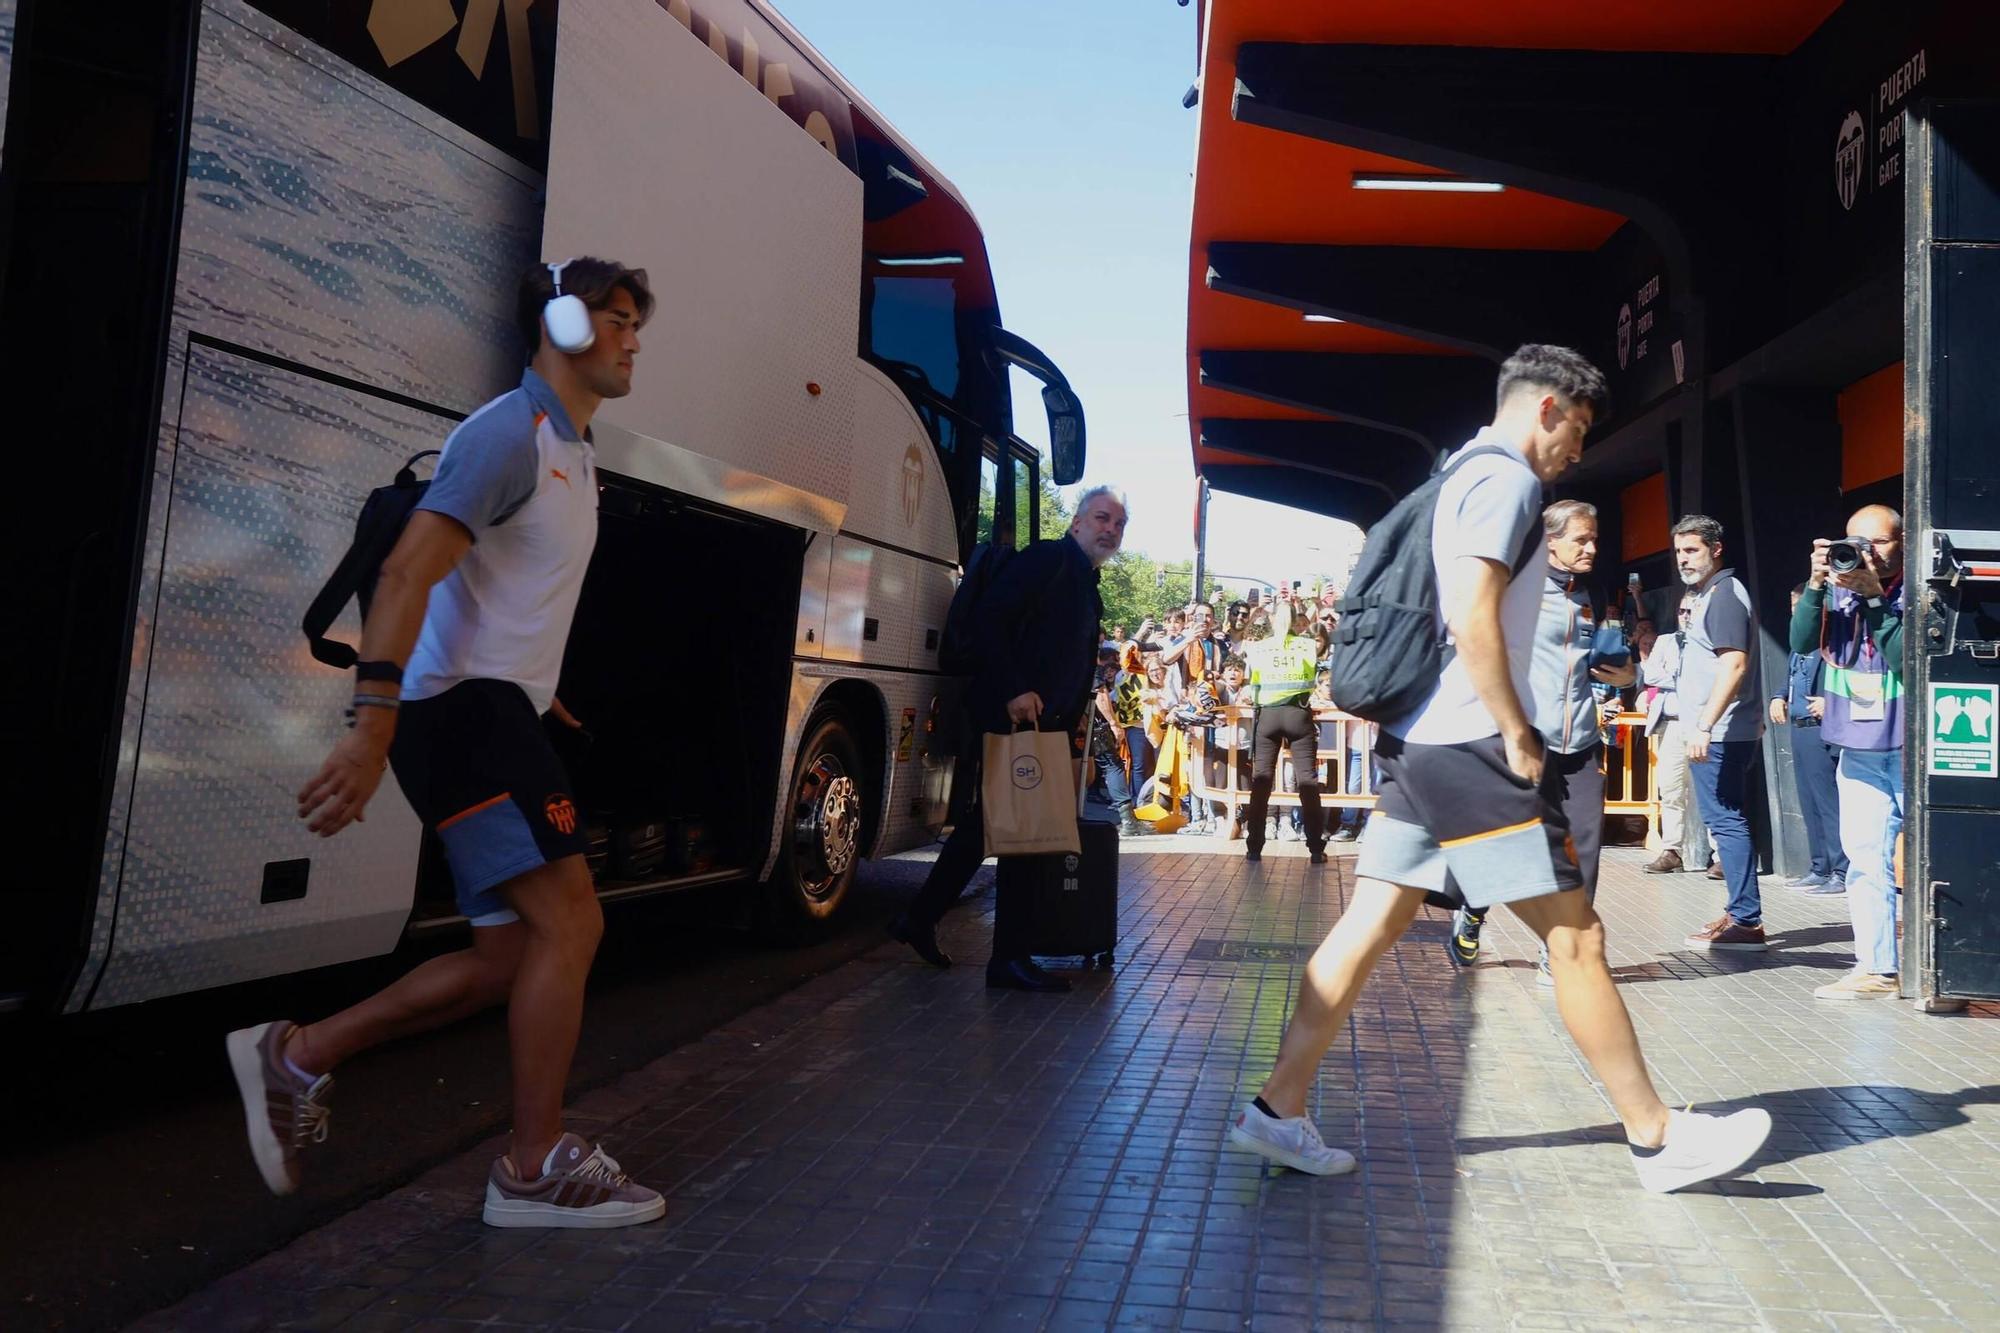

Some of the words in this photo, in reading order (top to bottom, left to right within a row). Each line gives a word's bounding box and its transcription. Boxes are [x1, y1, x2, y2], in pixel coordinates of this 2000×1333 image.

[1880, 49, 1926, 113] PUERTA
[1879, 111, 1905, 153] PORT
[1879, 153, 1900, 186] GATE
[1273, 656, 1295, 668] 541
[1016, 766, 1036, 777] SH
